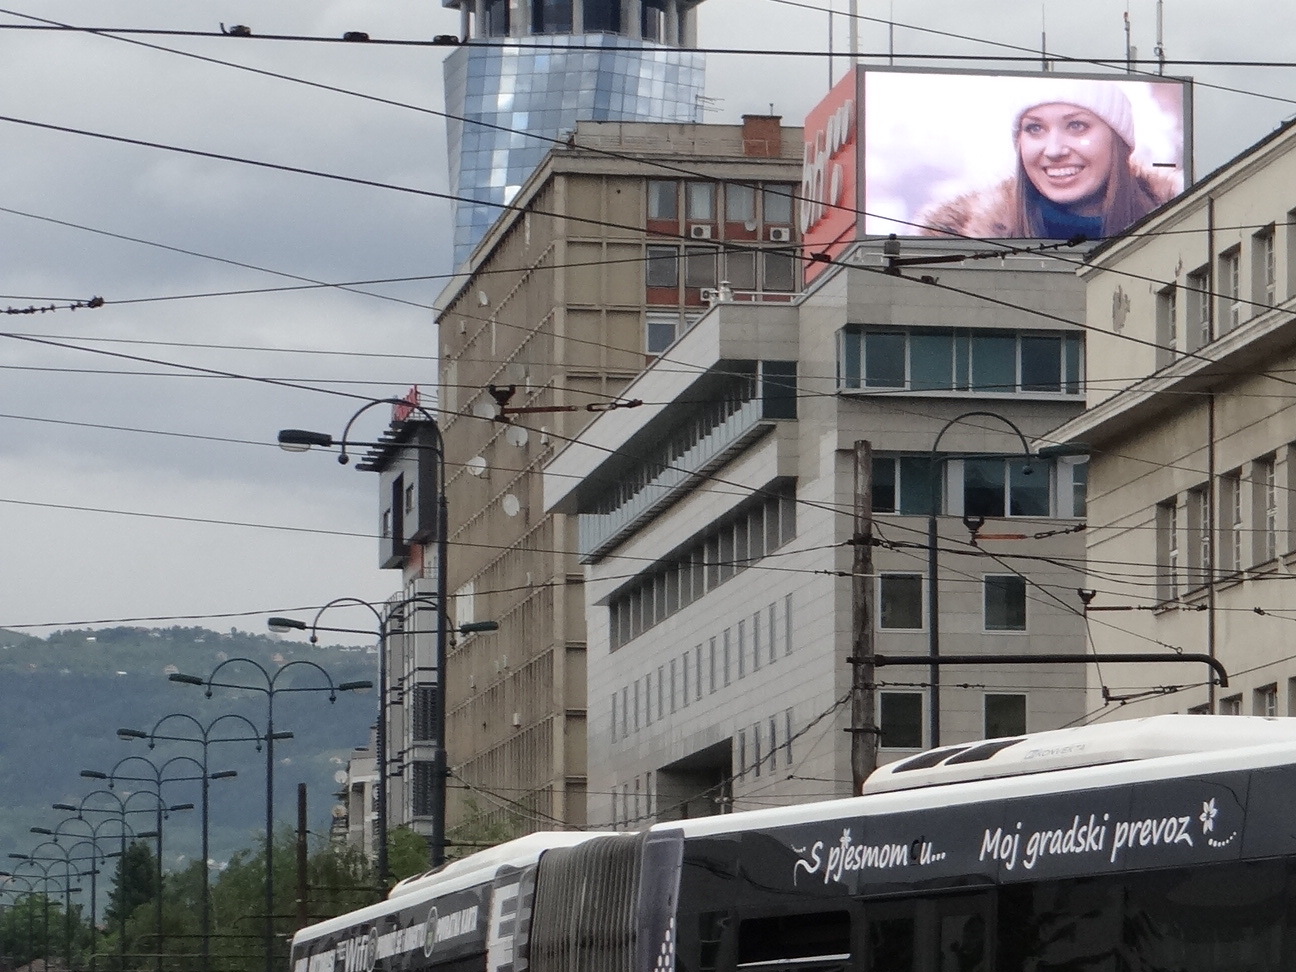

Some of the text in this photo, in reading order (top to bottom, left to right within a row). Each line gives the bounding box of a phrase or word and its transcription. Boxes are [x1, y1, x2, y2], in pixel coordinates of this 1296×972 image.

[979, 812, 1193, 870] Moj gradski prevoz
